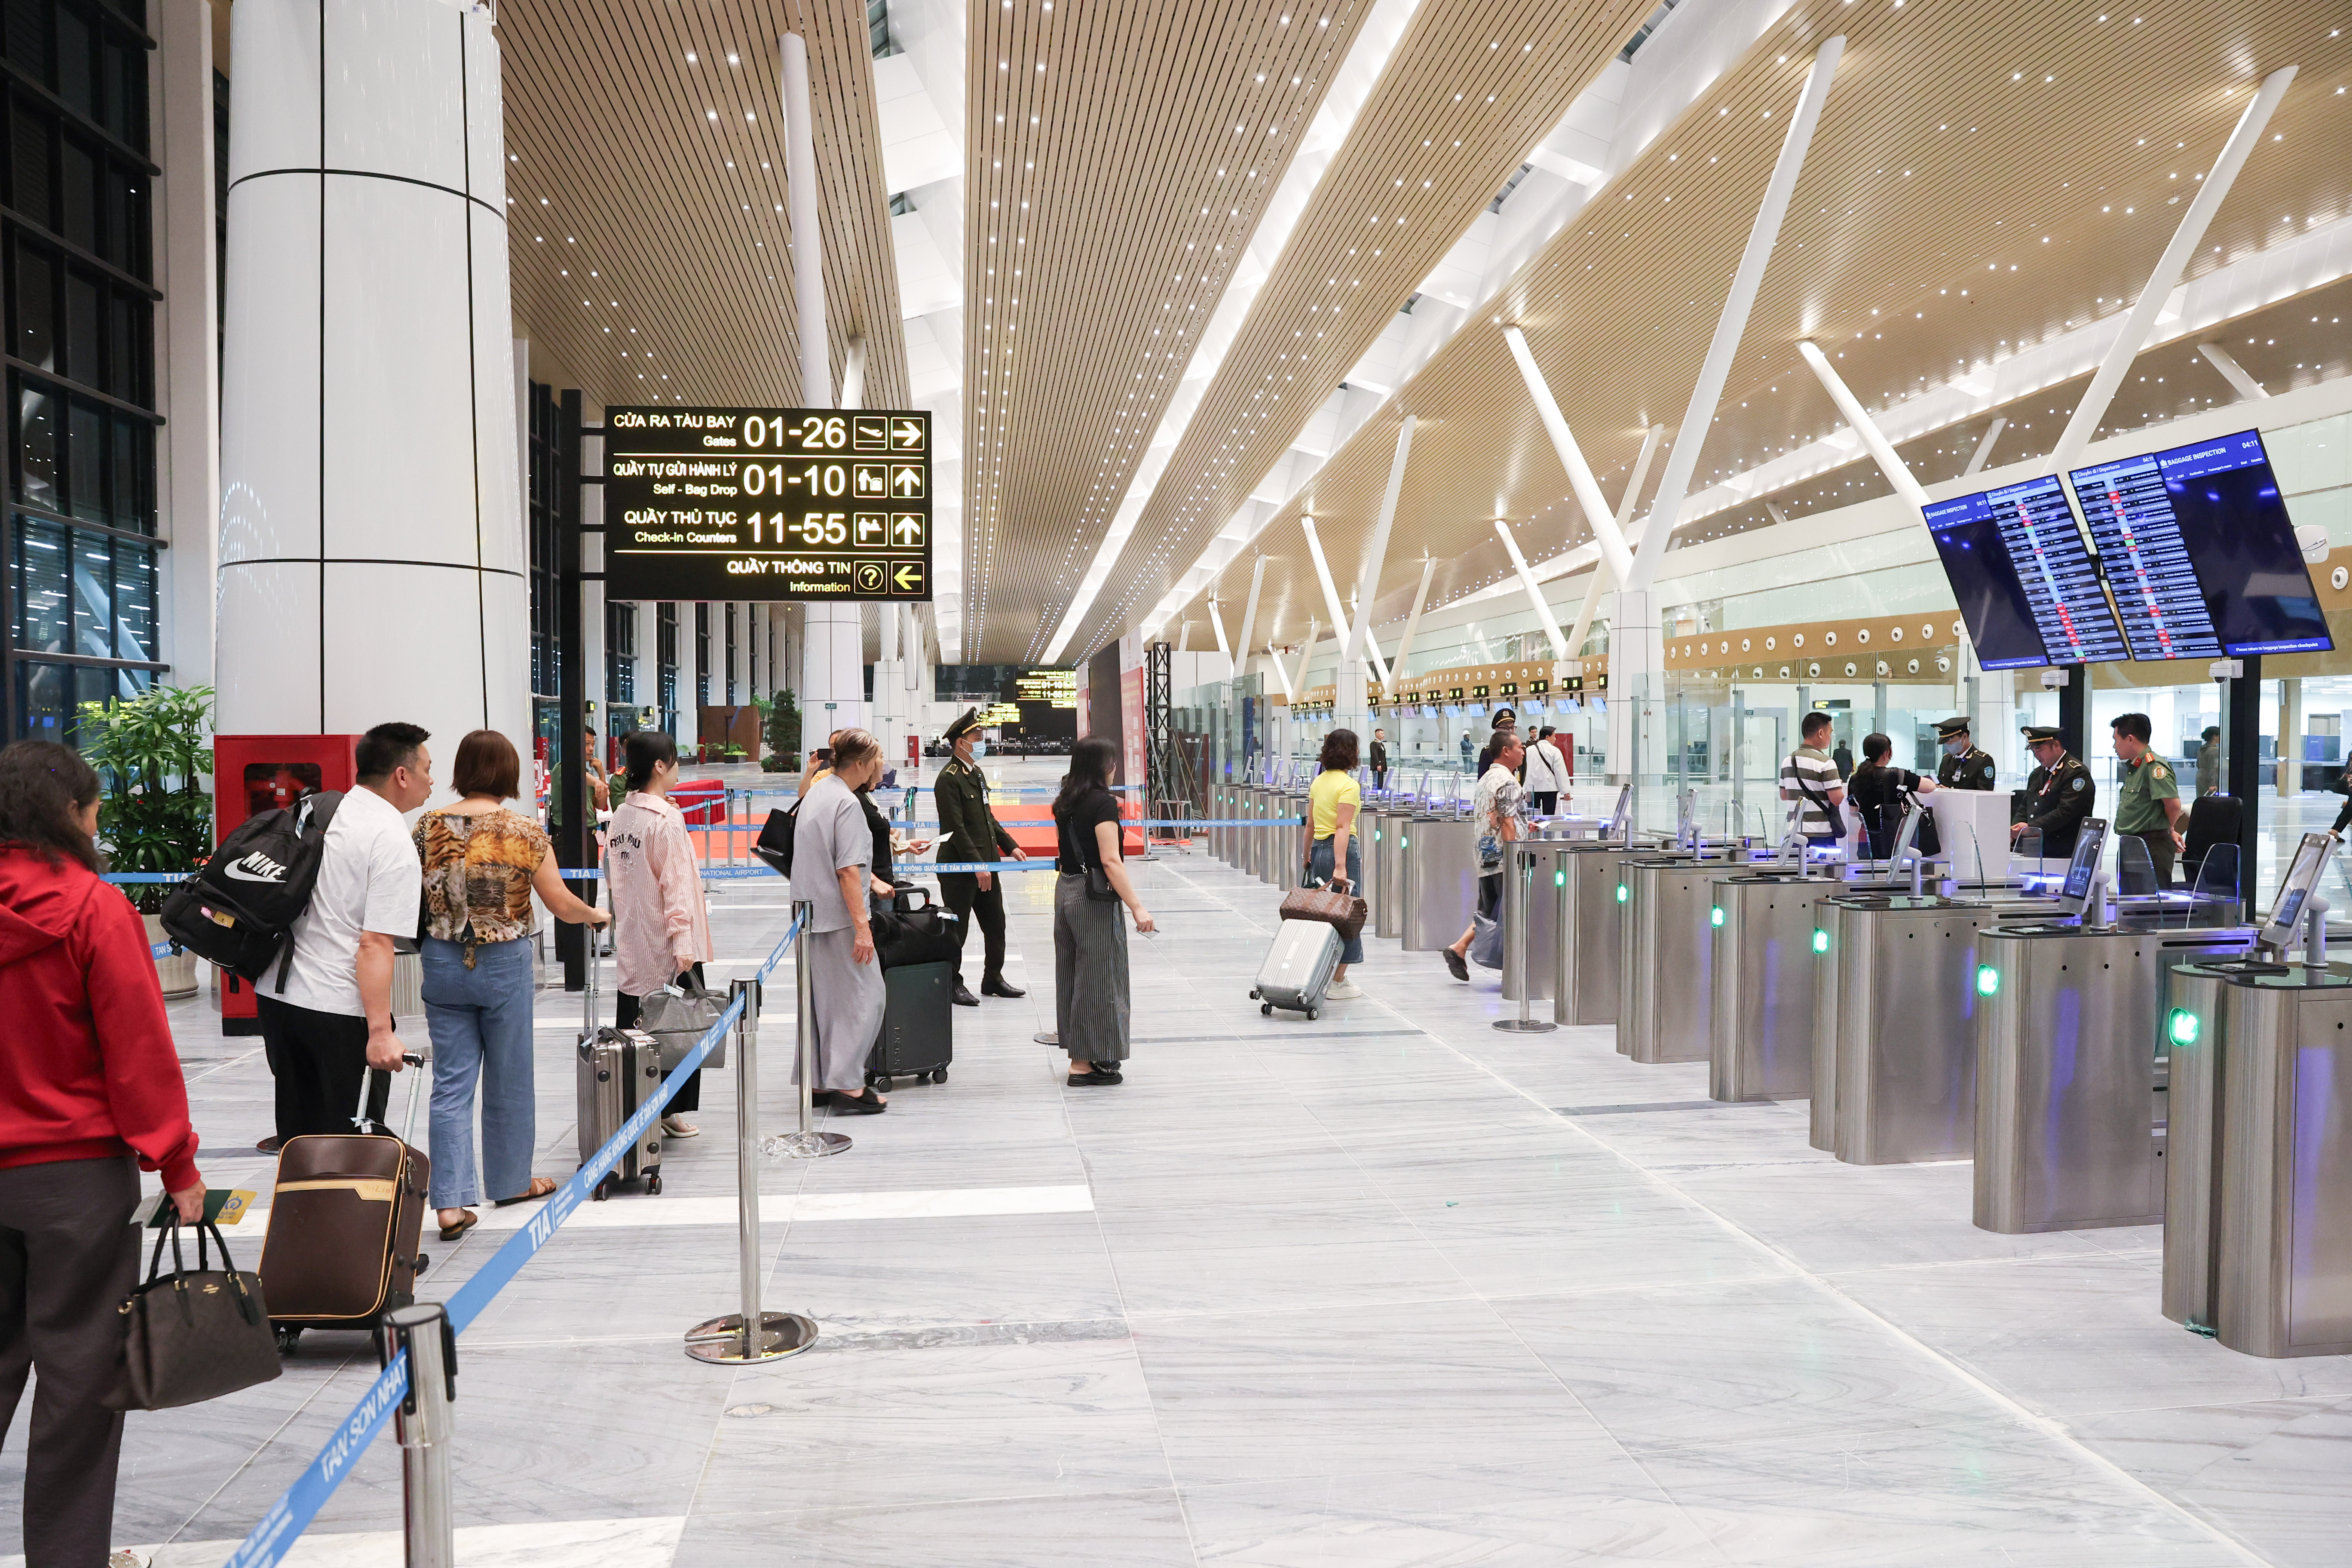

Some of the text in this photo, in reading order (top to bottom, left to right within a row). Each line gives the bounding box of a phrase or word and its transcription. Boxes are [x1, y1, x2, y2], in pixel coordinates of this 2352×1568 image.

[614, 412, 736, 428] CỬA RA TÀU BAY
[744, 416, 846, 449] 01-26
[703, 435, 736, 447] Gates
[2242, 439, 2258, 448] 04:11
[2168, 447, 2226, 466] BAGGAGE INSPECTION
[613, 461, 737, 478] QUẦY TỰ GỬI HÀNH LÝ
[2099, 464, 2120, 473] Departures
[744, 464, 845, 496] 01-10
[653, 484, 676, 494] Self
[686, 484, 707, 497] Bag
[710, 484, 737, 497] Drop
[625, 508, 737, 527] QUẦY THỦ TỤC
[1930, 504, 1968, 517] BAGGAGE INSPECTION
[747, 512, 846, 544] 11-55
[635, 532, 737, 543] Check-in Counters
[727, 557, 850, 574] QUẦY THÔNG TIN
[790, 582, 850, 591] Information
[241, 851, 287, 880] NIKE
[570, 869, 591, 878] TIA
[940, 863, 947, 871] TẾ
[162, 873, 191, 883] TIA
[155, 946, 165, 956] TAN
[700, 1035, 710, 1059] TIA
[584, 1164, 598, 1188] CẢNG
[598, 1145, 612, 1172] HÀNG
[612, 1130, 628, 1159] KHÔNG
[627, 1114, 639, 1141] QUỐC
[638, 1109, 644, 1128] TẾ
[643, 1102, 652, 1122] TÂN
[528, 1209, 551, 1252] TIA
[322, 1354, 406, 1482] TAN SON NHAT
